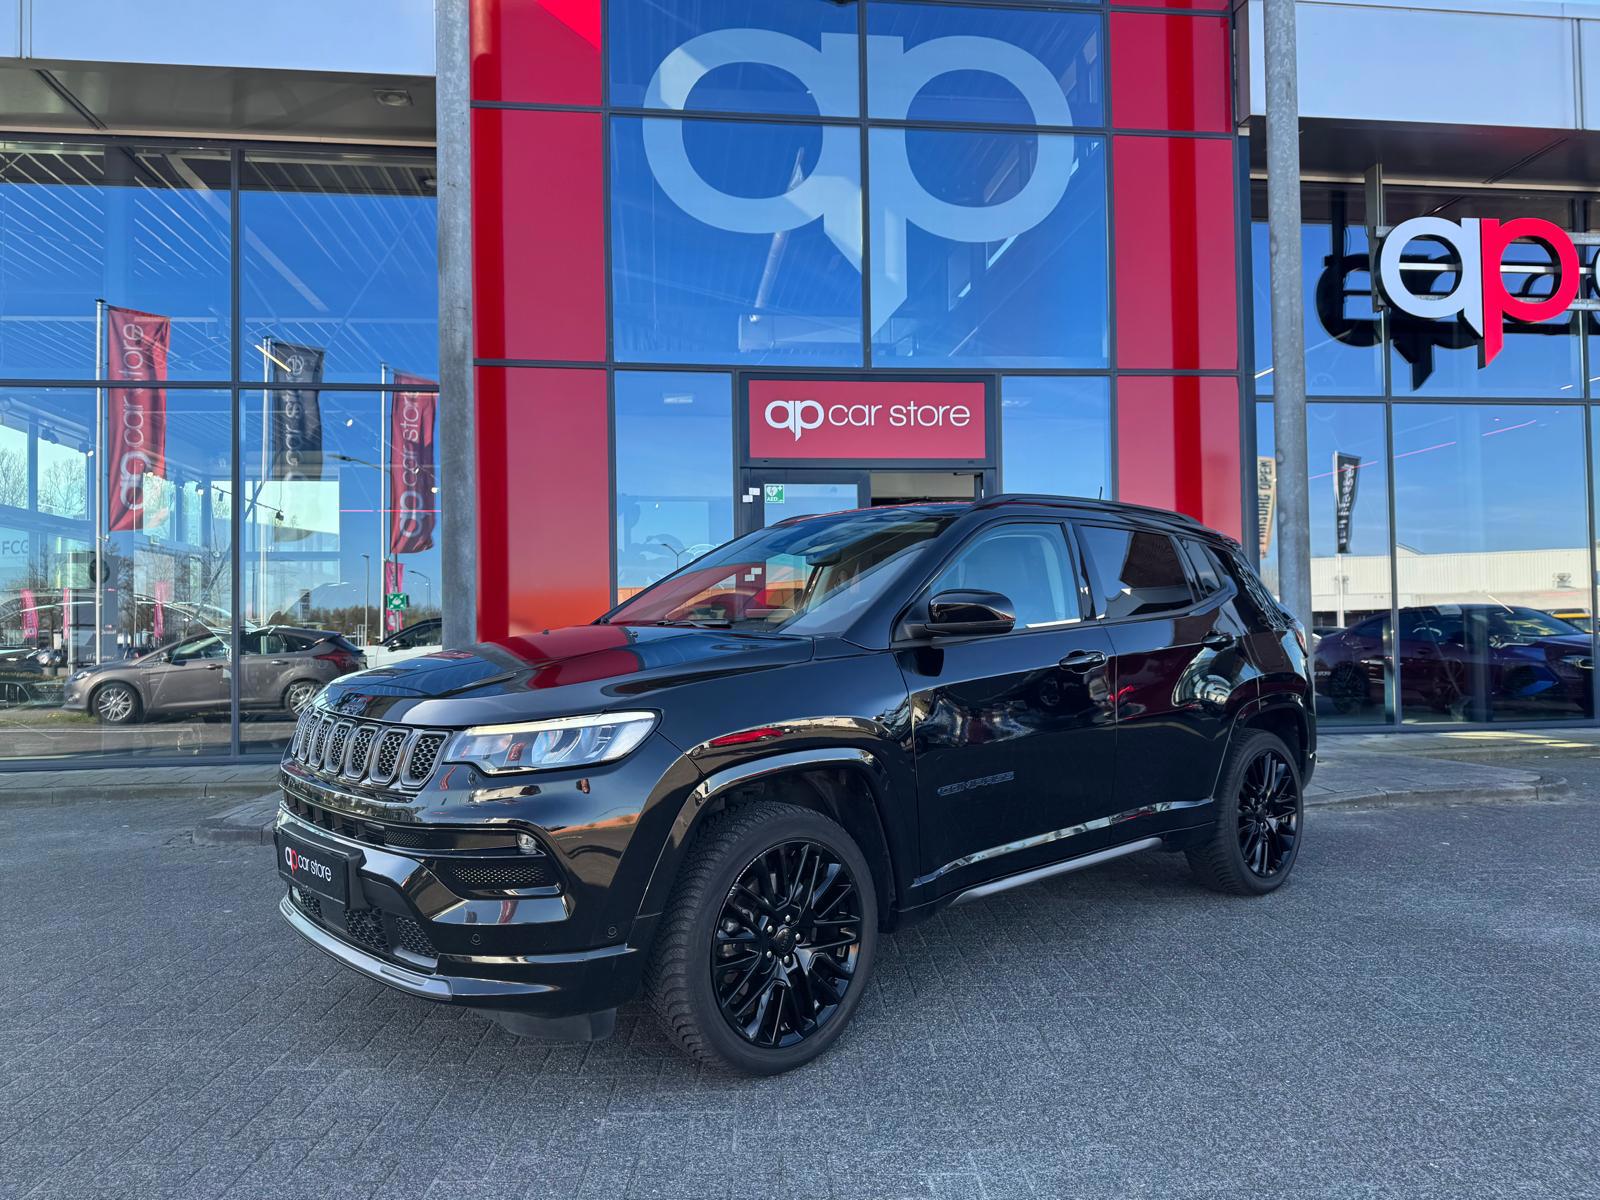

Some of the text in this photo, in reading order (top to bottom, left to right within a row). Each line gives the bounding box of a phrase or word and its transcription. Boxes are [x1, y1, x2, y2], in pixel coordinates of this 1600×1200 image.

[643, 28, 1075, 339] ap
[1380, 216, 1580, 368] ap
[764, 399, 970, 442] ap car store
[403, 445, 418, 486] car
[285, 846, 332, 882] ap car store
